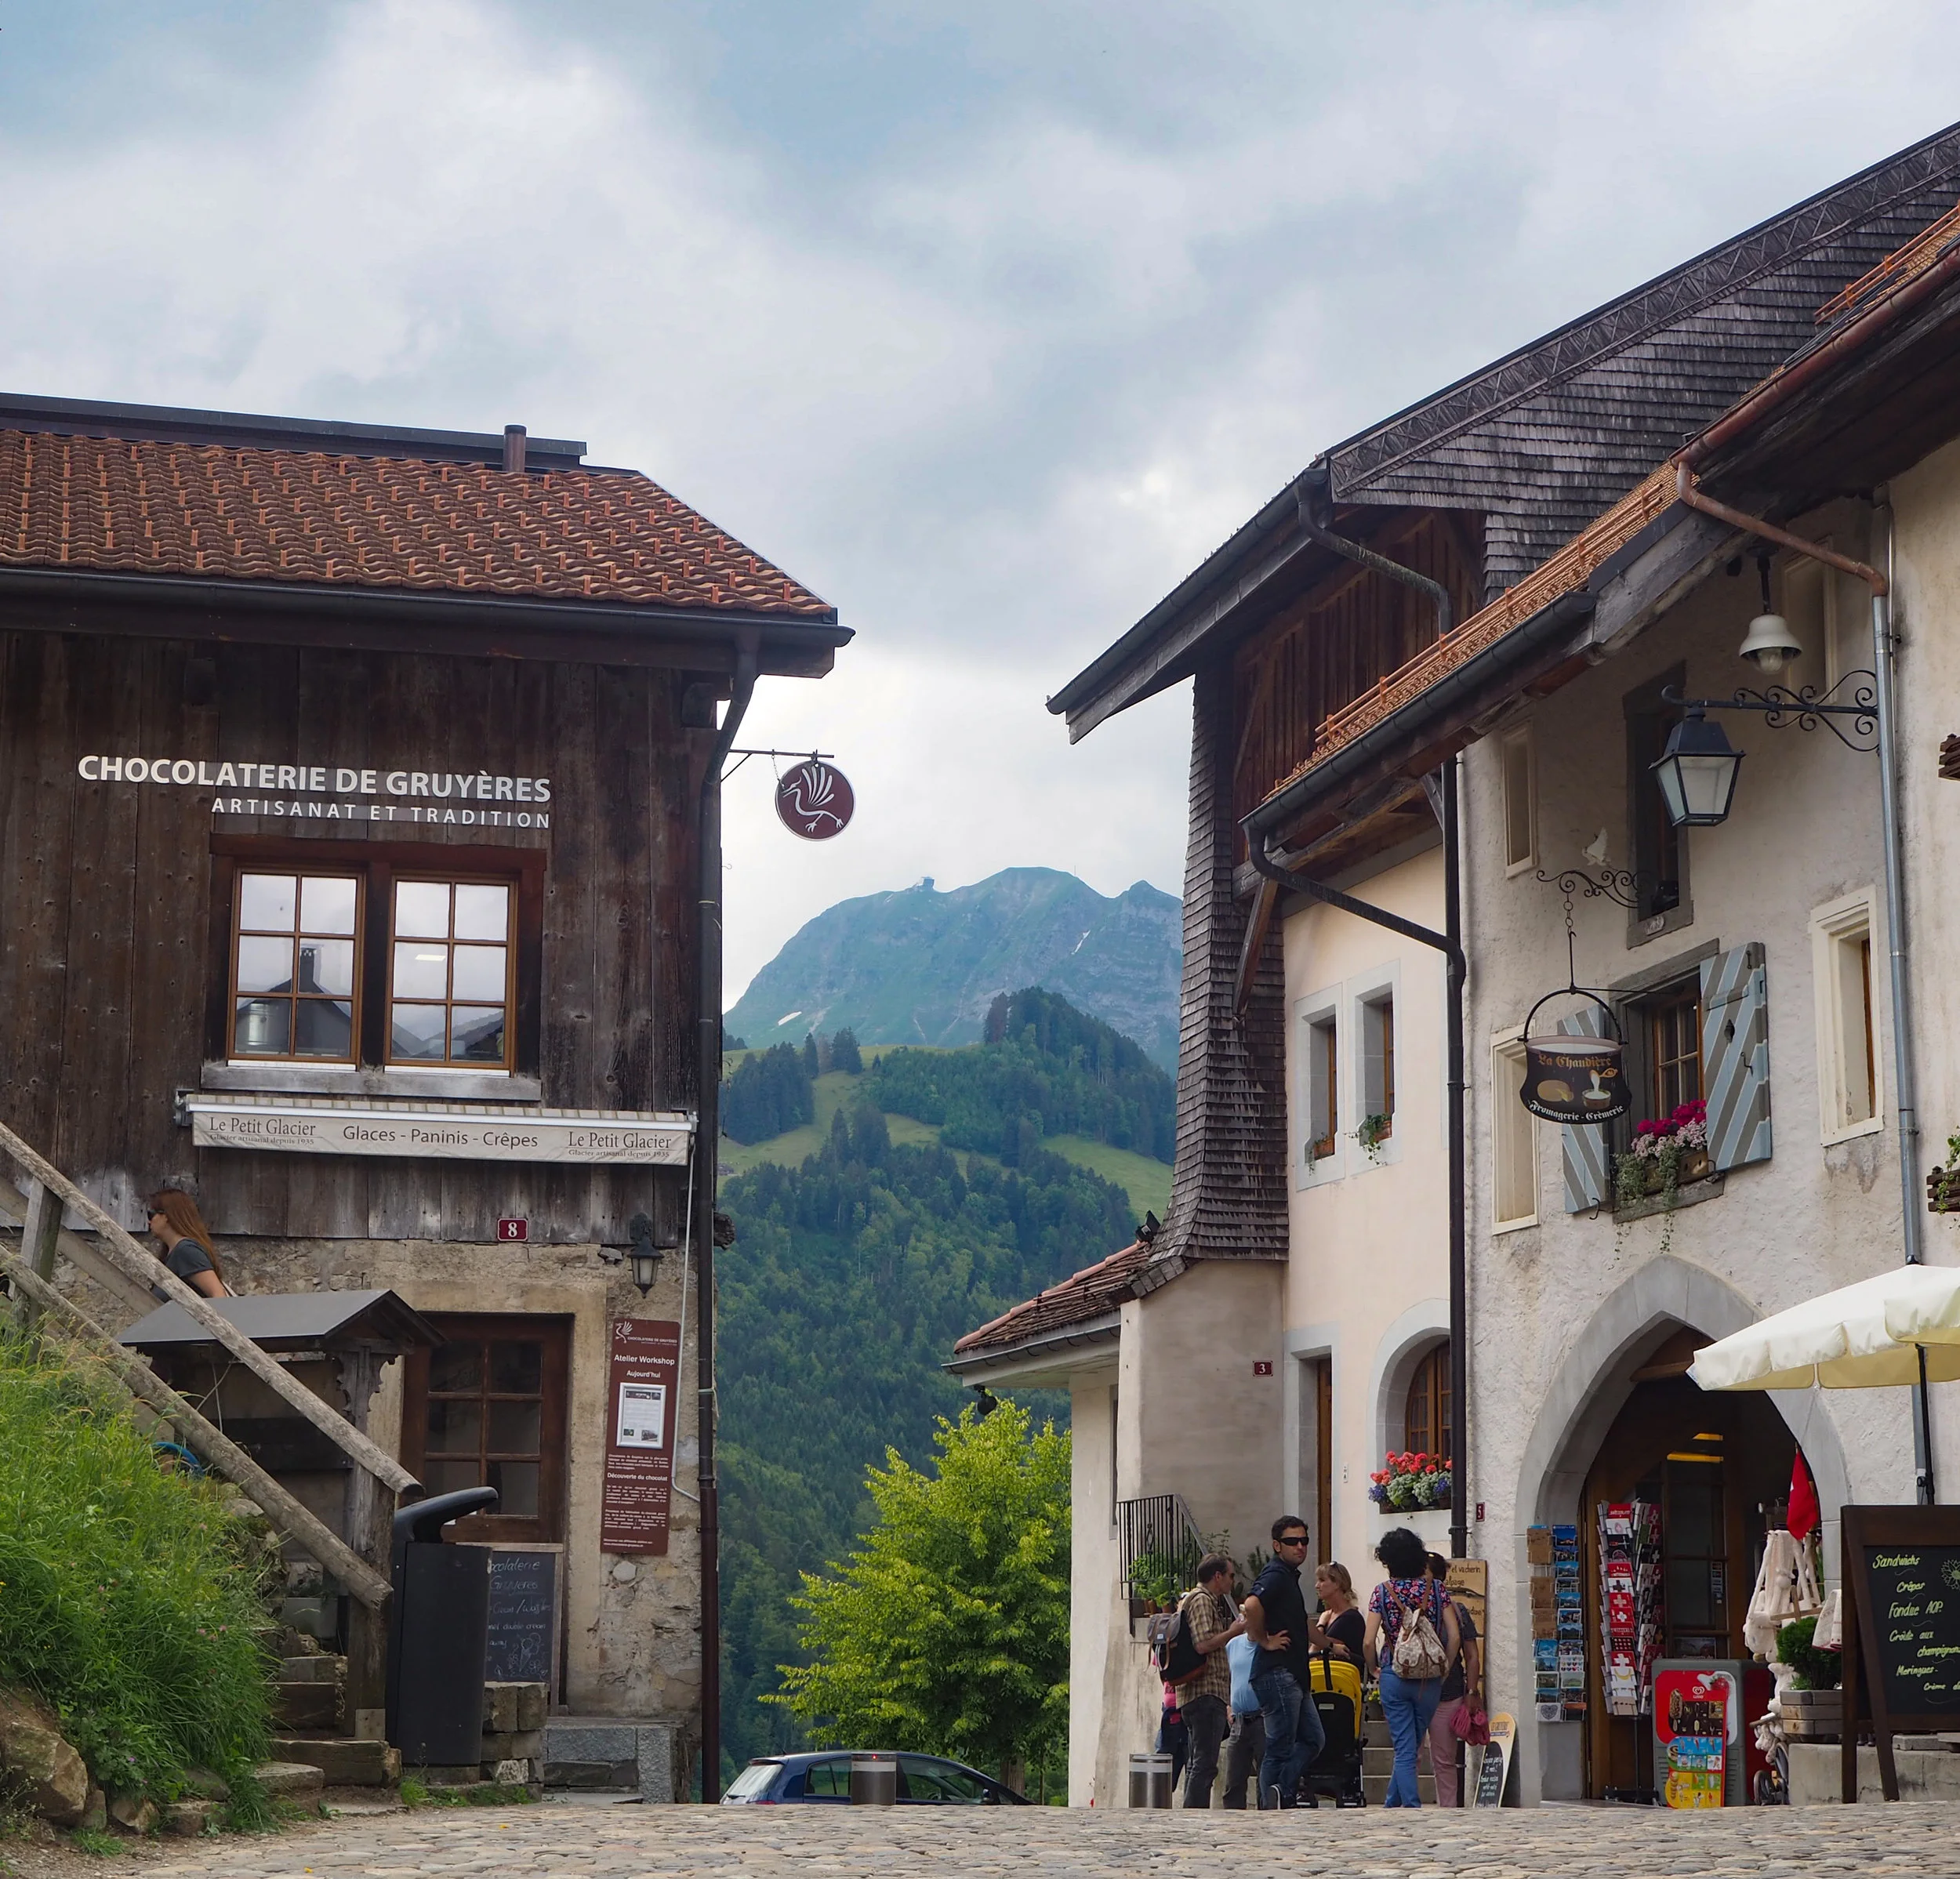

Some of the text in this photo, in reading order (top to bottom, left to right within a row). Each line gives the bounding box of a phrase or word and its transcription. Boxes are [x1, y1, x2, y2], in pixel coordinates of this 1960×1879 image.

[78, 755, 551, 803] CHOCOLATERIE DE GRUYÈRES
[212, 797, 549, 829] ARTISANAT ET TRADITION
[1538, 1053, 1552, 1065] La
[1529, 1100, 1580, 1120] Fromagerie
[210, 1117, 316, 1136] Le Petit Glacier
[270, 1137, 296, 1145] depuis
[343, 1126, 396, 1141] Glaces
[412, 1129, 468, 1144] Paninis
[483, 1132, 538, 1150] Crêpes
[568, 1131, 672, 1148] Le Petit Glacier
[628, 1149, 651, 1158] depuis
[508, 1222, 517, 1237] 8
[614, 1354, 675, 1366] Atelier Workshop
[1259, 1363, 1266, 1373] 3
[1872, 1554, 1920, 1569] Sandwichs
[1888, 1602, 1920, 1619] Fondue
